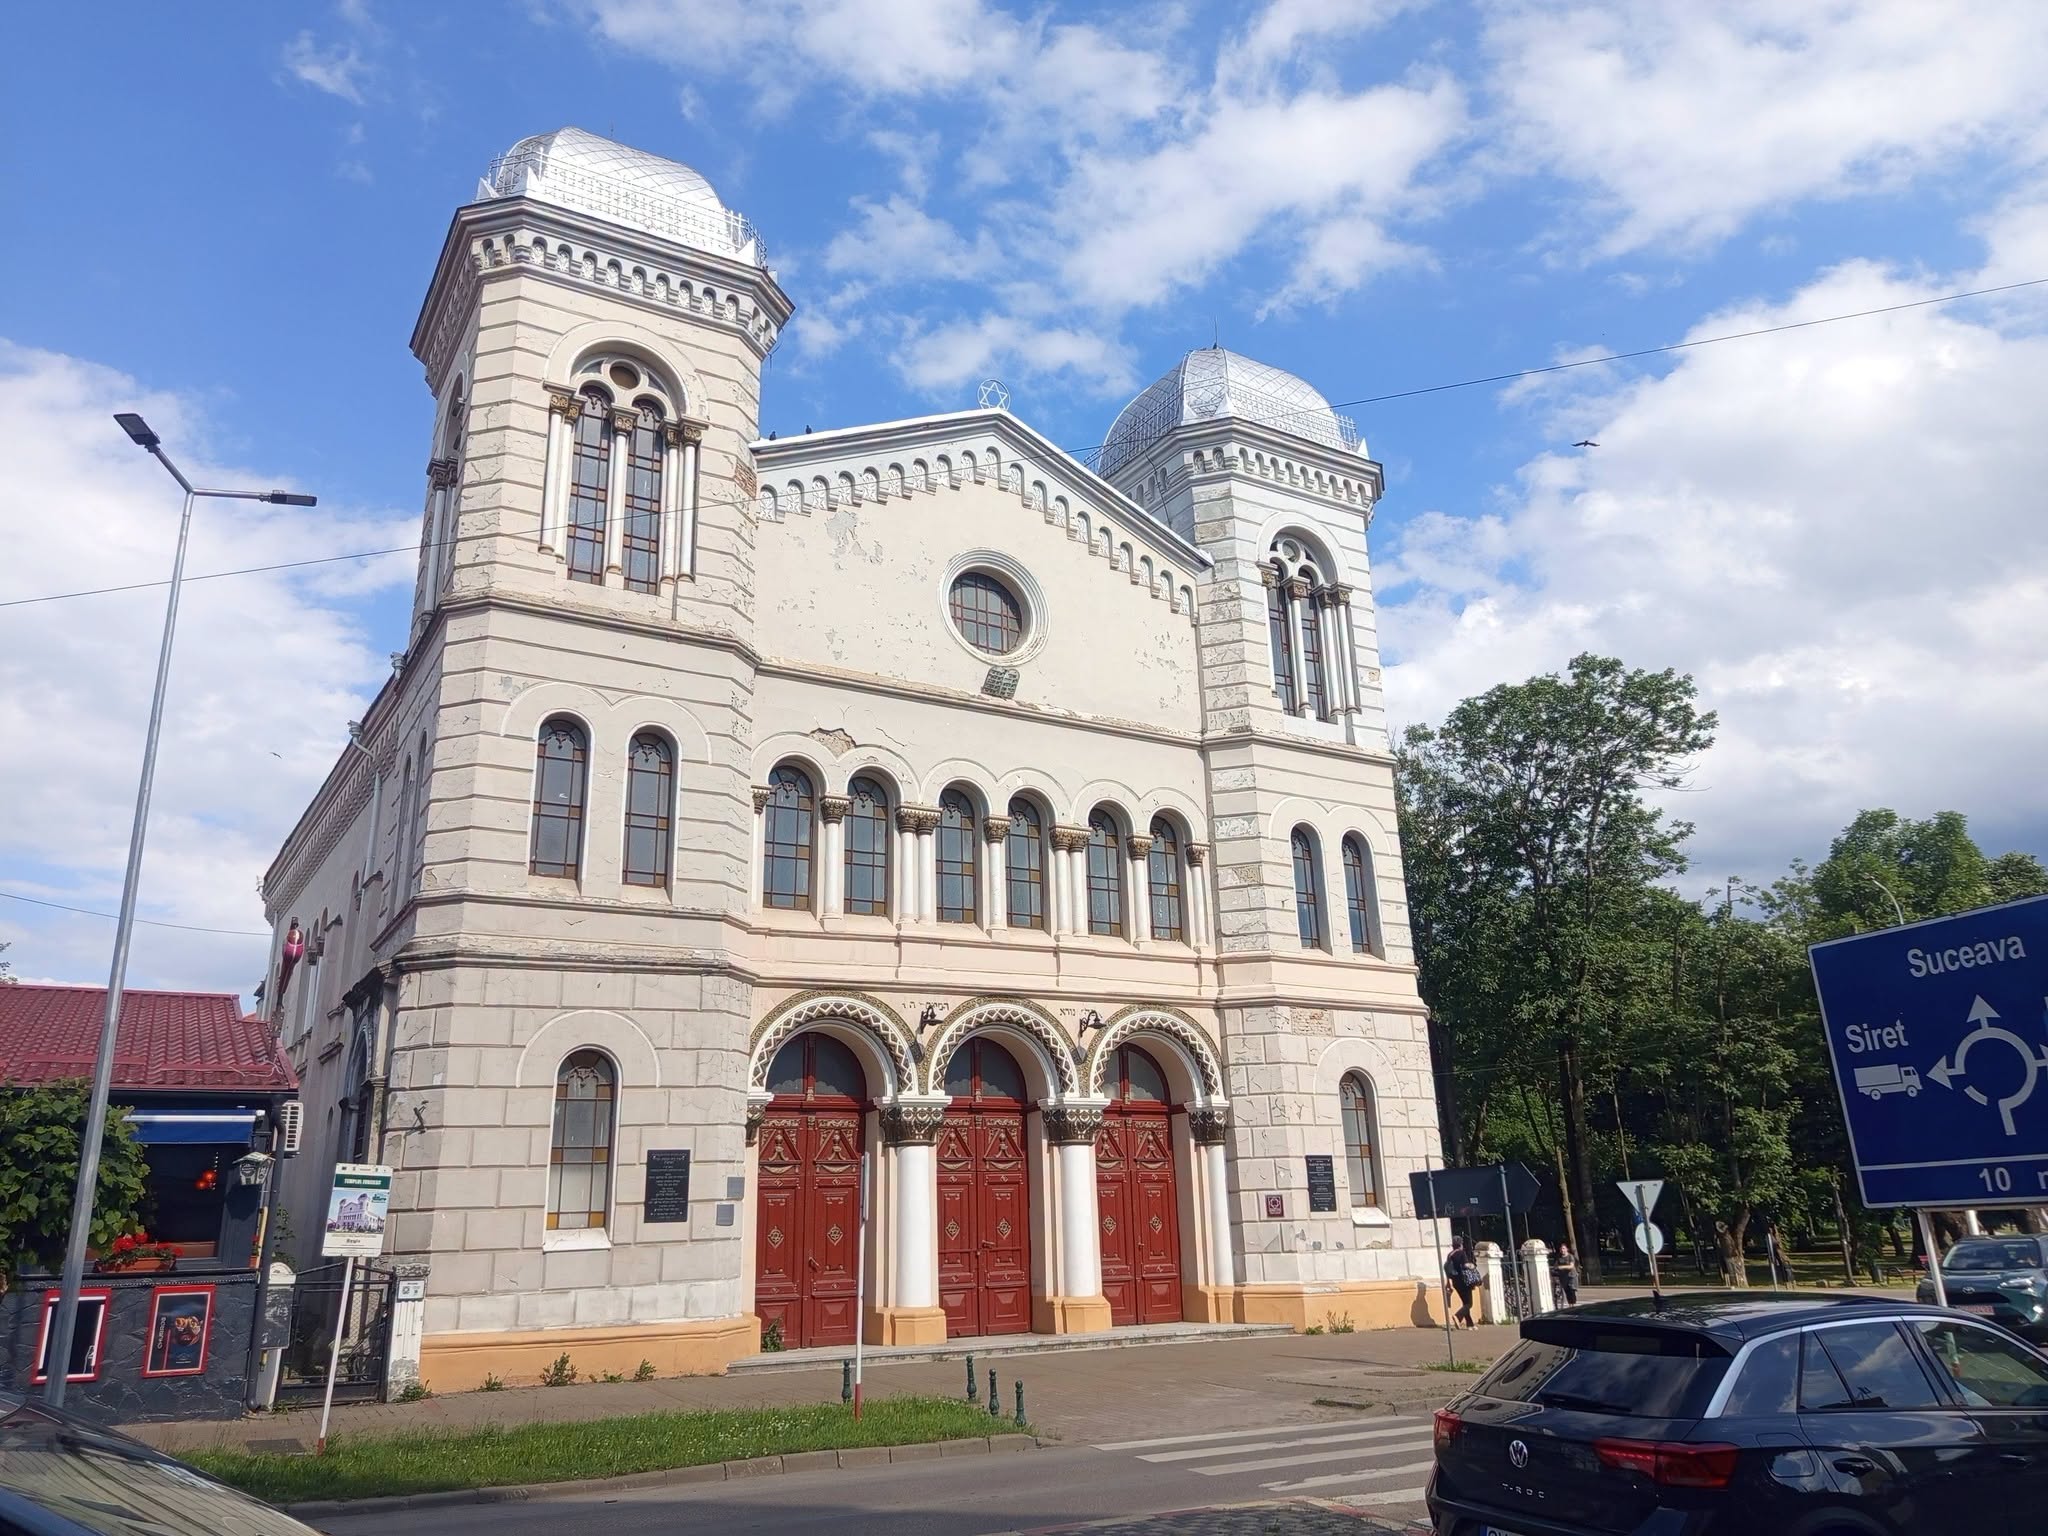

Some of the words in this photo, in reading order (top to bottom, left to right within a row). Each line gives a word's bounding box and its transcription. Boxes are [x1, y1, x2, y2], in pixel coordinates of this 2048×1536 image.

[1907, 936, 2026, 978] Suceava
[1845, 1019, 1908, 1054] Siret
[1979, 1167, 2012, 1192] 10
